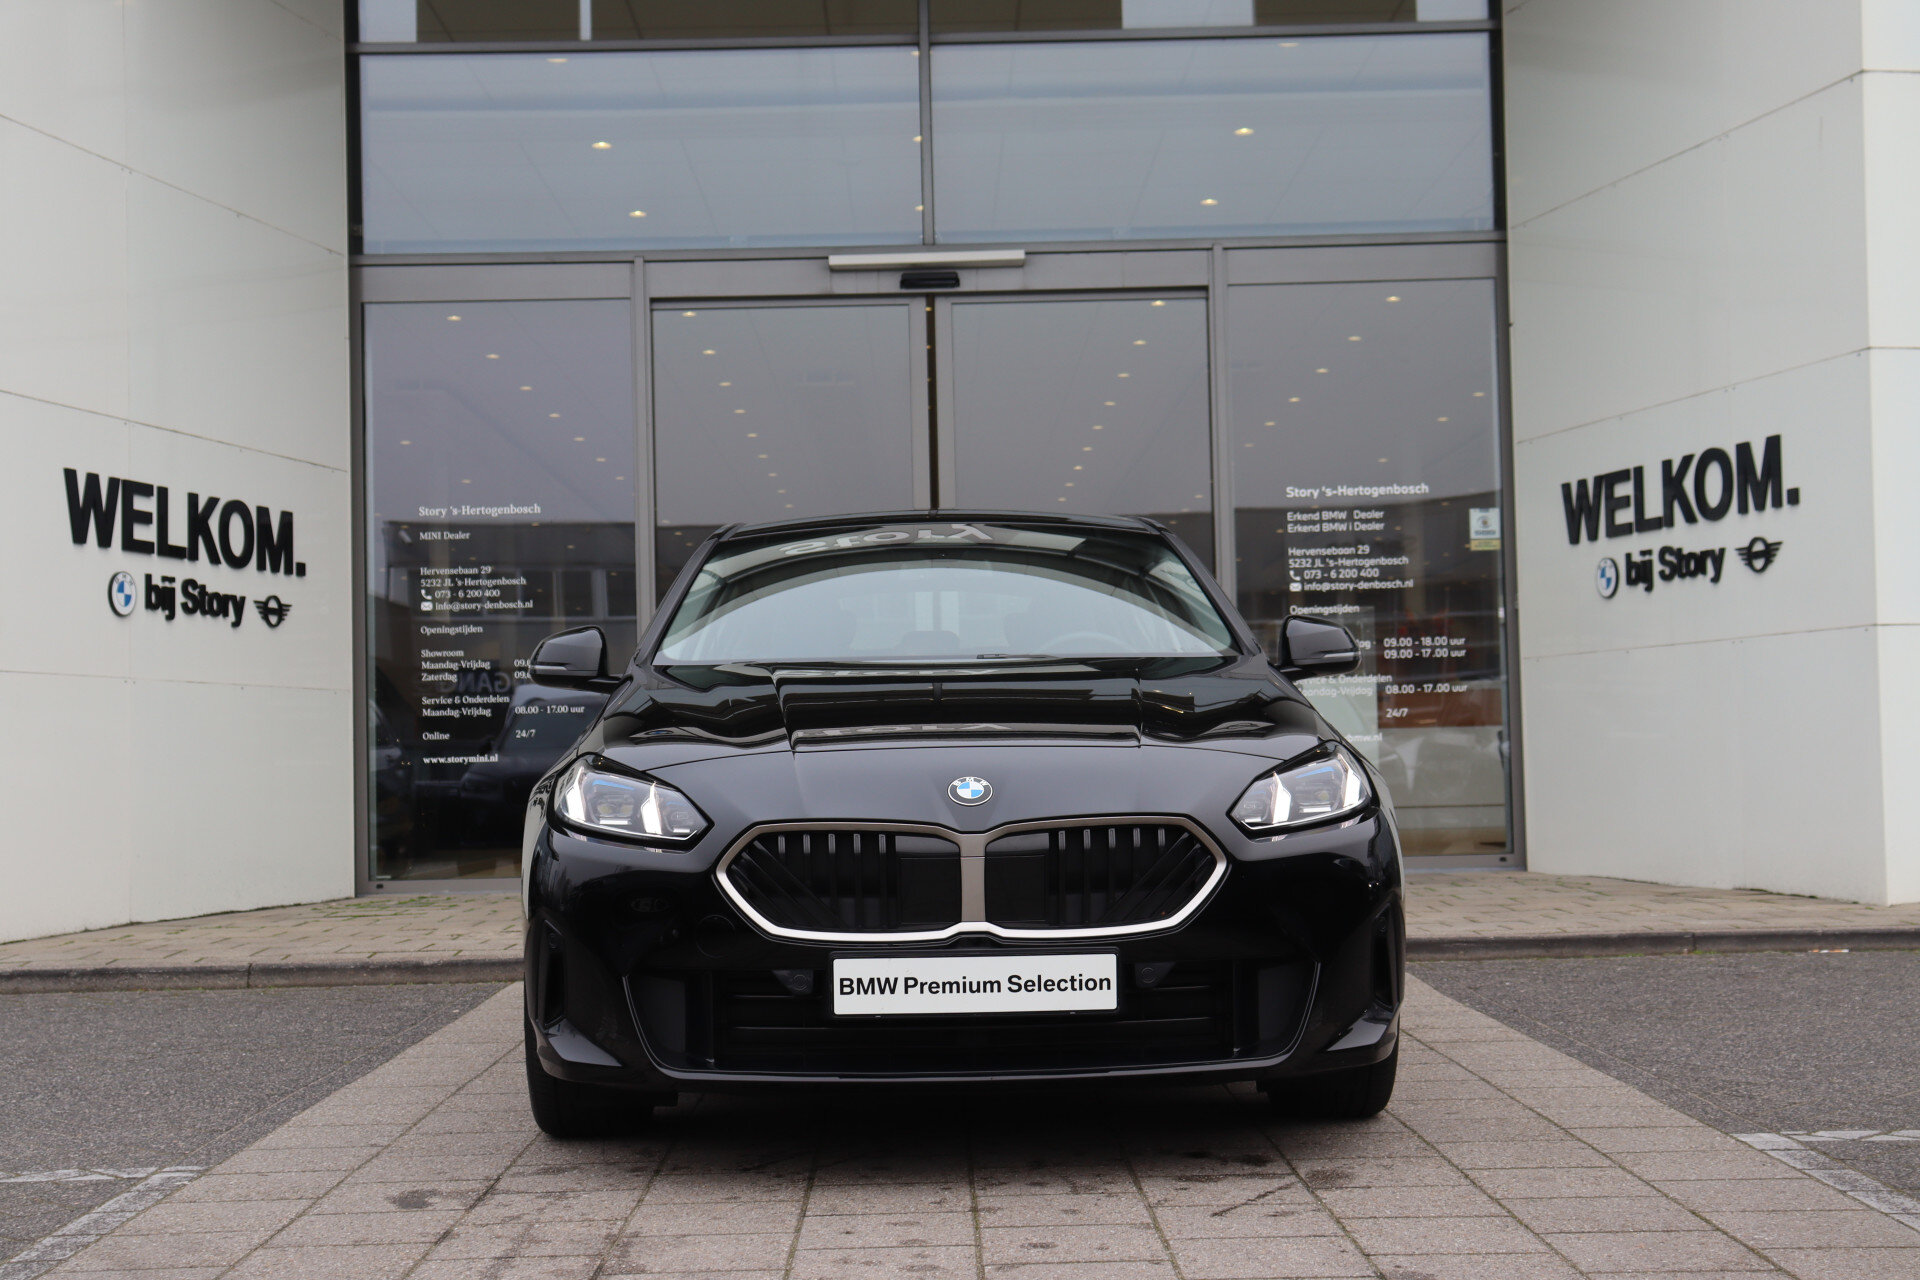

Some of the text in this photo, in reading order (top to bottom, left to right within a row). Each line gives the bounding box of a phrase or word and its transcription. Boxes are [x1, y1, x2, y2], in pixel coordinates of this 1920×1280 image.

[1286, 483, 1429, 498] Story 's-Hertogenbosch
[1561, 434, 1800, 545] WELKOM.
[419, 504, 541, 518] Story 's-Hertogenbosch
[1287, 510, 1384, 521] Erkend BMW Dealer
[63, 467, 306, 577] WELKOM.
[1287, 523, 1320, 533] Erkend
[1322, 522, 1347, 532] BMW
[1354, 521, 1385, 531] Dealer
[419, 531, 471, 540] MINI Dealer
[1288, 545, 1370, 556] Hervensebaan 29
[1288, 556, 1409, 569] 5232 JL 's-Hertogenbosch
[420, 566, 492, 576] Hervensebaan 29
[1303, 570, 1322, 579] 073
[1330, 569, 1337, 578] 6
[1338, 569, 1358, 578] 200
[1360, 568, 1379, 578] 400
[1625, 546, 1726, 592] bij Story
[420, 576, 527, 587] 5232 JL 's-Hertogenbosch
[1303, 579, 1414, 592] info@story-denbosch.nl
[434, 590, 451, 598] 073
[458, 589, 464, 598] 6
[466, 589, 482, 598] 200
[484, 589, 500, 597] 400
[145, 573, 246, 628] bij Story
[435, 600, 534, 612] info@story-denbosch.nl
[1289, 605, 1360, 616] Openingstijden
[420, 625, 483, 635] Openingstijden
[1383, 637, 1412, 647] 09.00
[1421, 636, 1448, 646] 18.00
[1449, 637, 1466, 646] uur
[421, 649, 464, 658] Showroom
[1384, 649, 1413, 659] 09.00
[1450, 649, 1466, 658] uur
[421, 659, 531, 670] Maandag-Vrijdag 09.
[421, 671, 531, 682] Zaterdag 09.
[1338, 674, 1393, 684] Onderdelen
[1385, 684, 1414, 694] 08.00
[1451, 684, 1468, 693] uur
[422, 697, 452, 705] Service
[462, 695, 510, 704] Onderdelen
[422, 707, 491, 717] Maandag-Vrijdag
[515, 706, 538, 714] 08.00
[546, 705, 568, 714] 17.00
[1386, 708, 1408, 718] 24/7
[422, 732, 450, 740] Online
[515, 729, 536, 739] 24/7
[423, 754, 498, 764] www.storymini.nl
[838, 973, 1111, 996] BMW Premium Selection
